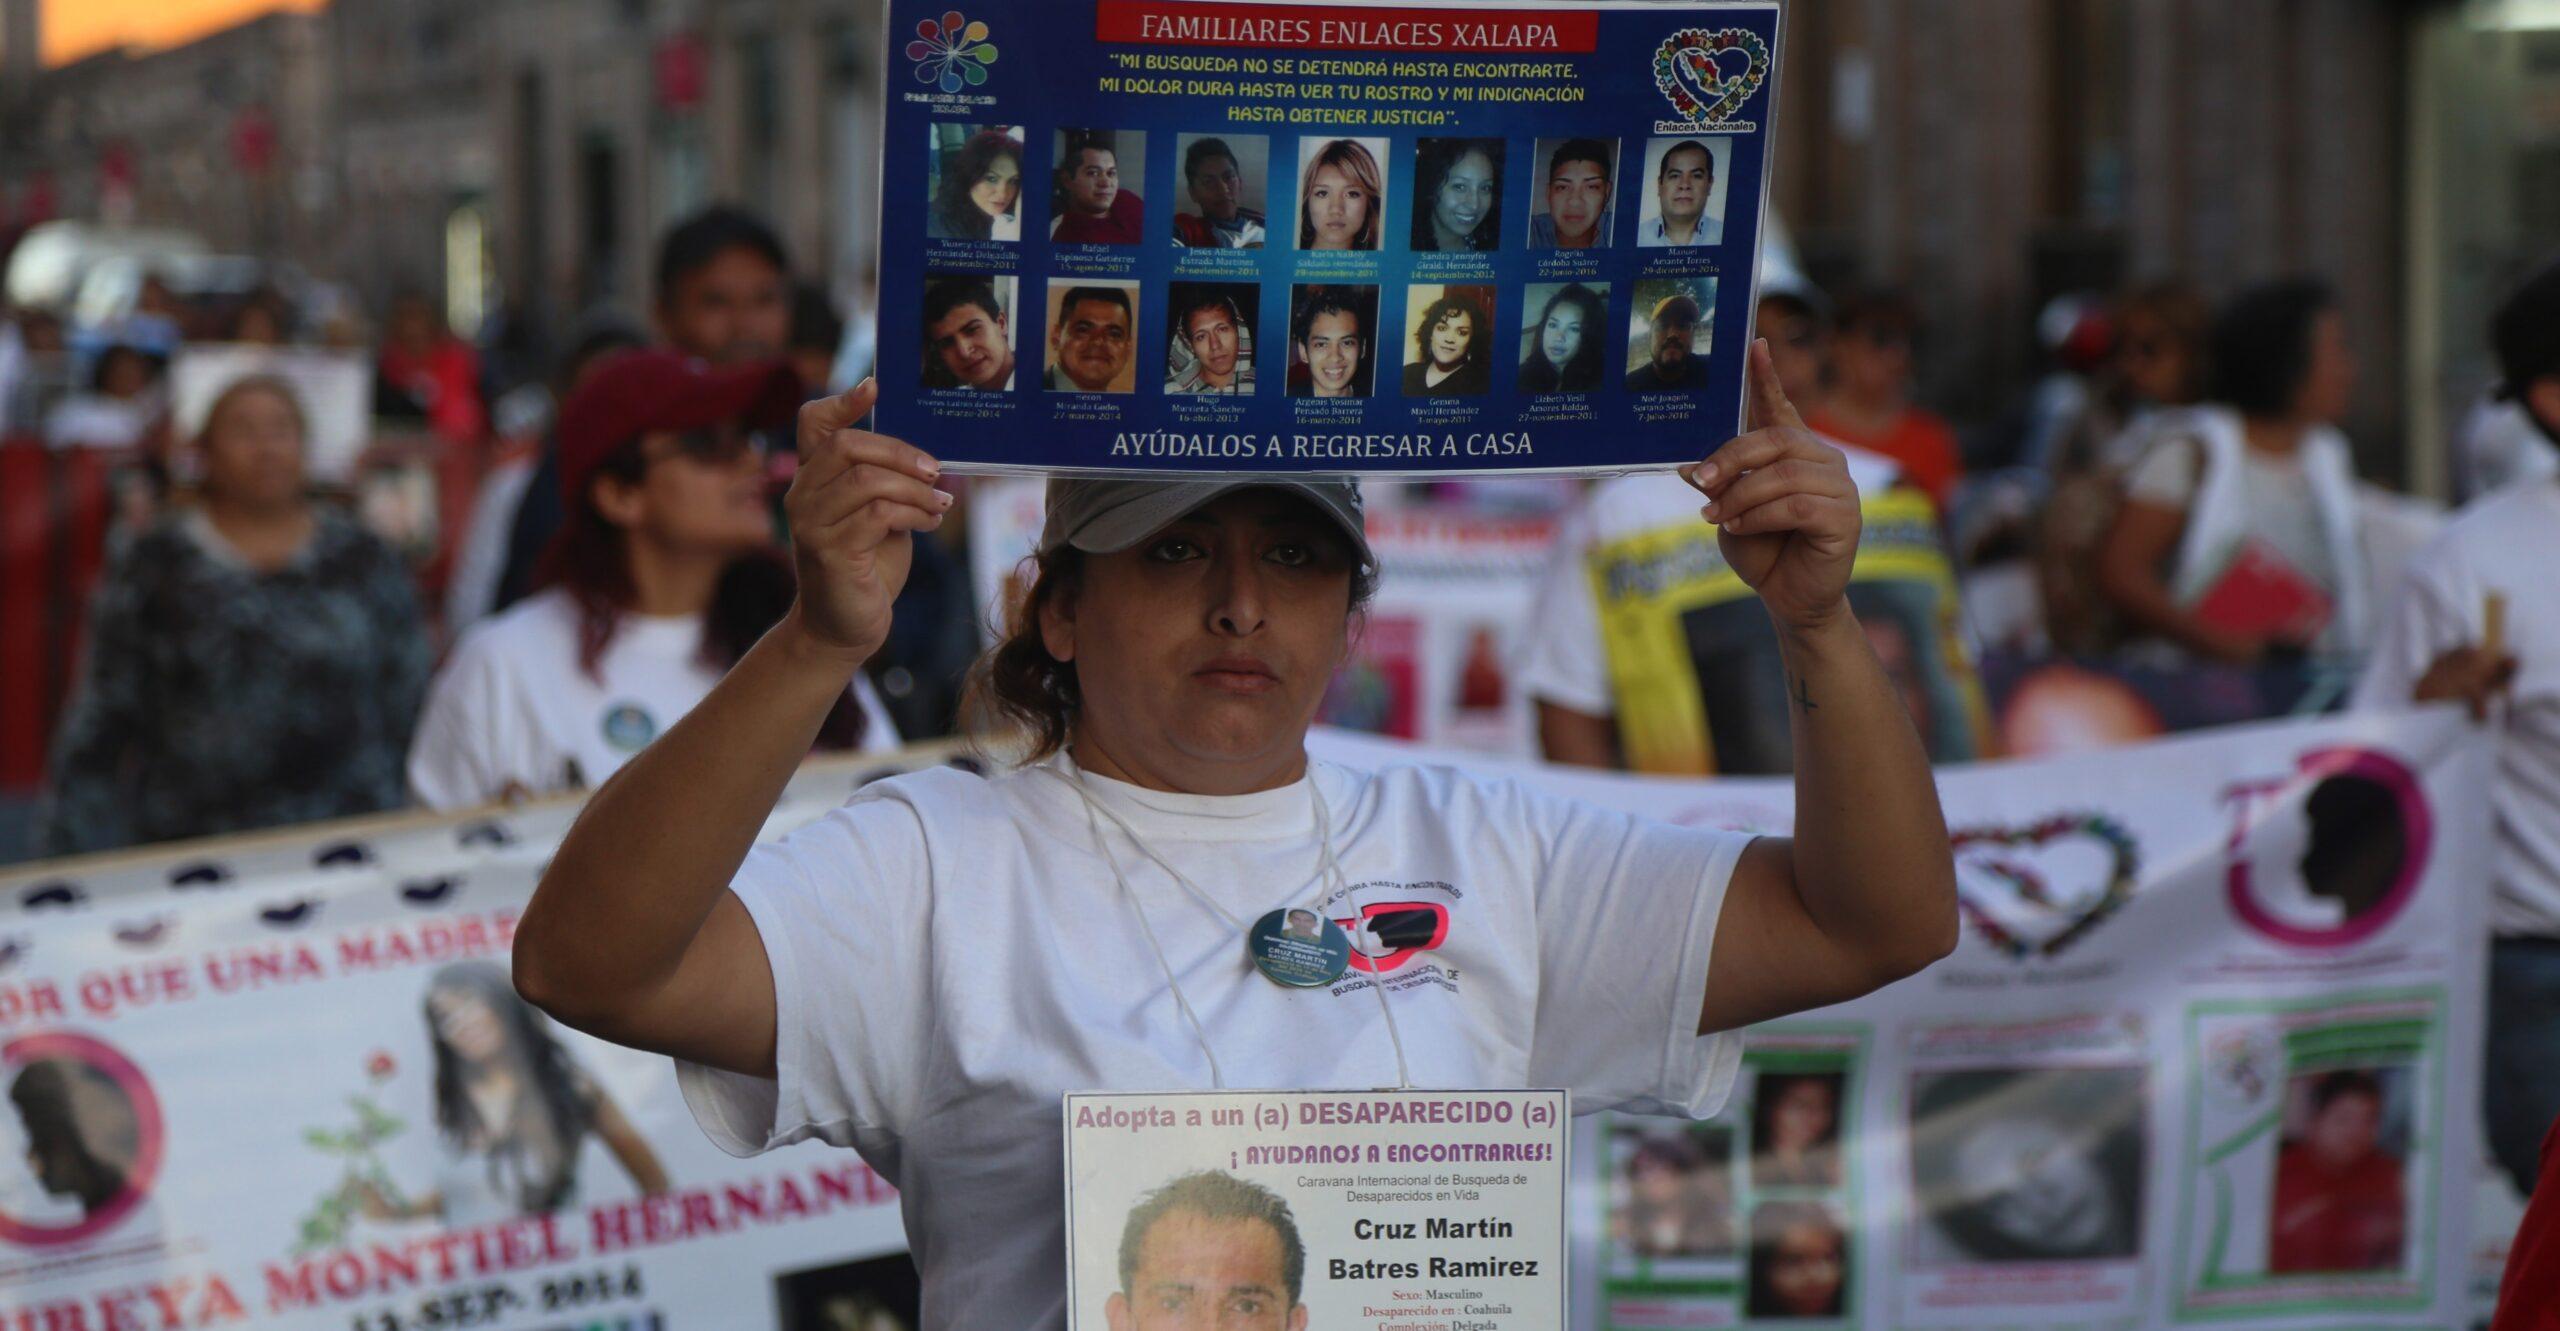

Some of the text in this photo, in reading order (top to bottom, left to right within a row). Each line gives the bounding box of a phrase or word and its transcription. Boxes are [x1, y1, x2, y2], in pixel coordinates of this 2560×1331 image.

[1141, 14, 1559, 47] FAMILIARES ENLACES XALAPA
[1146, 55, 1238, 73] BUSQUEDA
[1243, 58, 1268, 74] NO
[1272, 59, 1294, 74] SE
[1299, 58, 1388, 76] DETENDRÁ
[1392, 62, 1448, 77] HASTA
[1453, 63, 1578, 79] ENCONTRARTE.
[1100, 77, 1584, 101] MI DOLOR DURA HASTA VER TU ROSTRO Y MI INDIGNACIÓN
[1228, 106, 1285, 122] HASTA
[1289, 107, 1367, 124] OBTENER
[1656, 120, 1755, 132] Enlaces Nacionales
[1082, 244, 1109, 253] Rafael
[1421, 251, 1450, 261] Sandra
[1668, 248, 1698, 256] Manuel
[1446, 261, 1490, 270] Hernández
[1197, 395, 1220, 405] Hugo
[1436, 406, 1479, 415] Hernández
[1111, 428, 1534, 458] AYÚDALOS A REGRESAR A CASA
[1371, 880, 1401, 889] HASTA
[1268, 947, 1292, 957] CRUZ
[1447, 969, 1459, 980] DE
[78, 958, 197, 1020] QUE
[205, 946, 322, 994] UNA
[1332, 980, 1378, 997] BUSQU
[1076, 1100, 1557, 1133] Adopta a un (a) DESAPARECIDO (a)
[1246, 1144, 1360, 1165] AYUDANOS
[1367, 1144, 1380, 1164] A
[1387, 1143, 1552, 1163] ENCONTRARLES!
[1297, 1174, 1528, 1188] Caravana Internacional de Busqueda de
[1347, 1189, 1479, 1204] Desaparecidos en Vida
[1354, 1217, 1513, 1240] Cruz Martín
[264, 1211, 575, 1316] MONTIEL
[1329, 1256, 1539, 1280] Batres Ramirez
[1392, 1288, 1483, 1301] Sexo: Masculino
[1363, 1305, 1438, 1319] Desaparecido
[1441, 1307, 1455, 1316] en
[1464, 1303, 1512, 1315] Coahuila
[1452, 1319, 1497, 1331] Delgada
